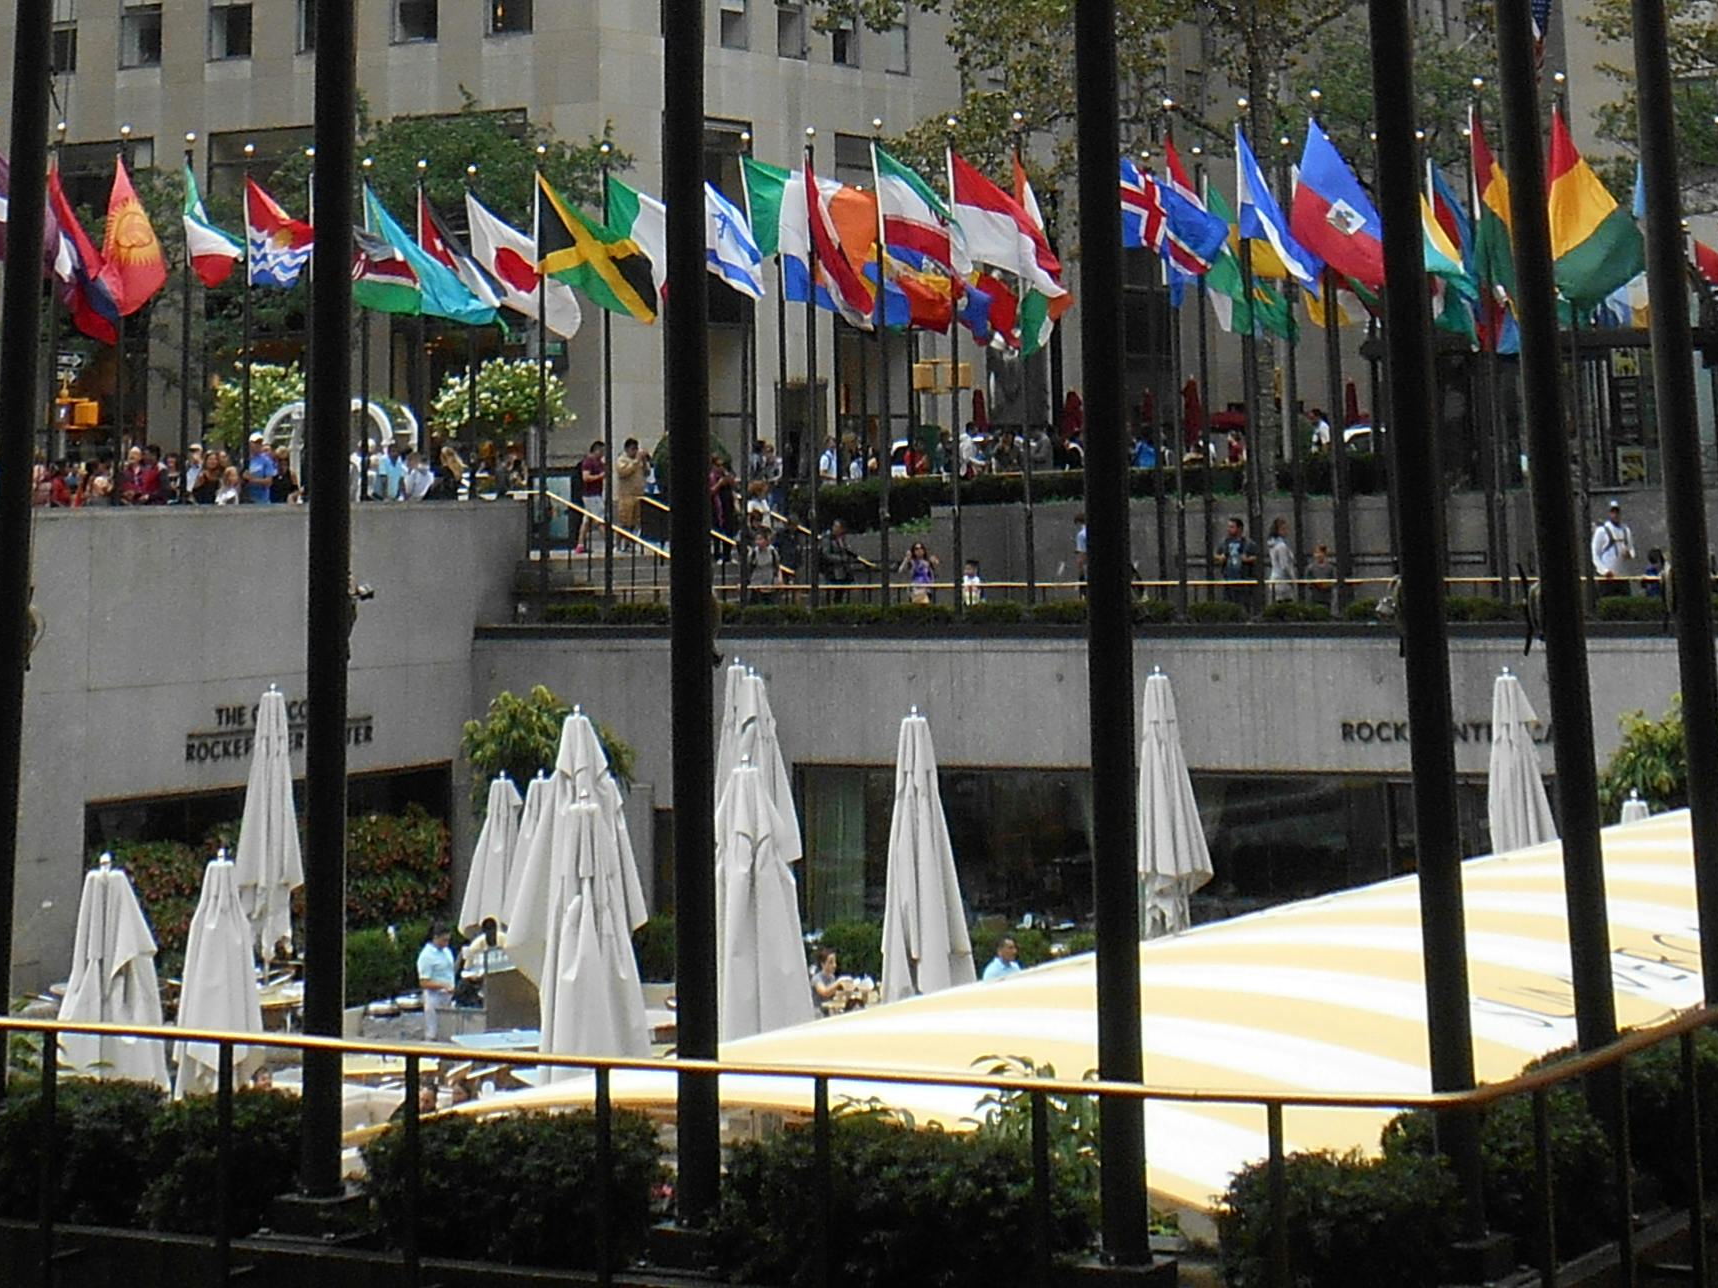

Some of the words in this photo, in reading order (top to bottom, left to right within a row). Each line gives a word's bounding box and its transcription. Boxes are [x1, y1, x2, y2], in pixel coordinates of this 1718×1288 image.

[215, 705, 247, 727] THE
[1341, 720, 1409, 743] ROCK
[185, 731, 304, 763] ROCKEFER
